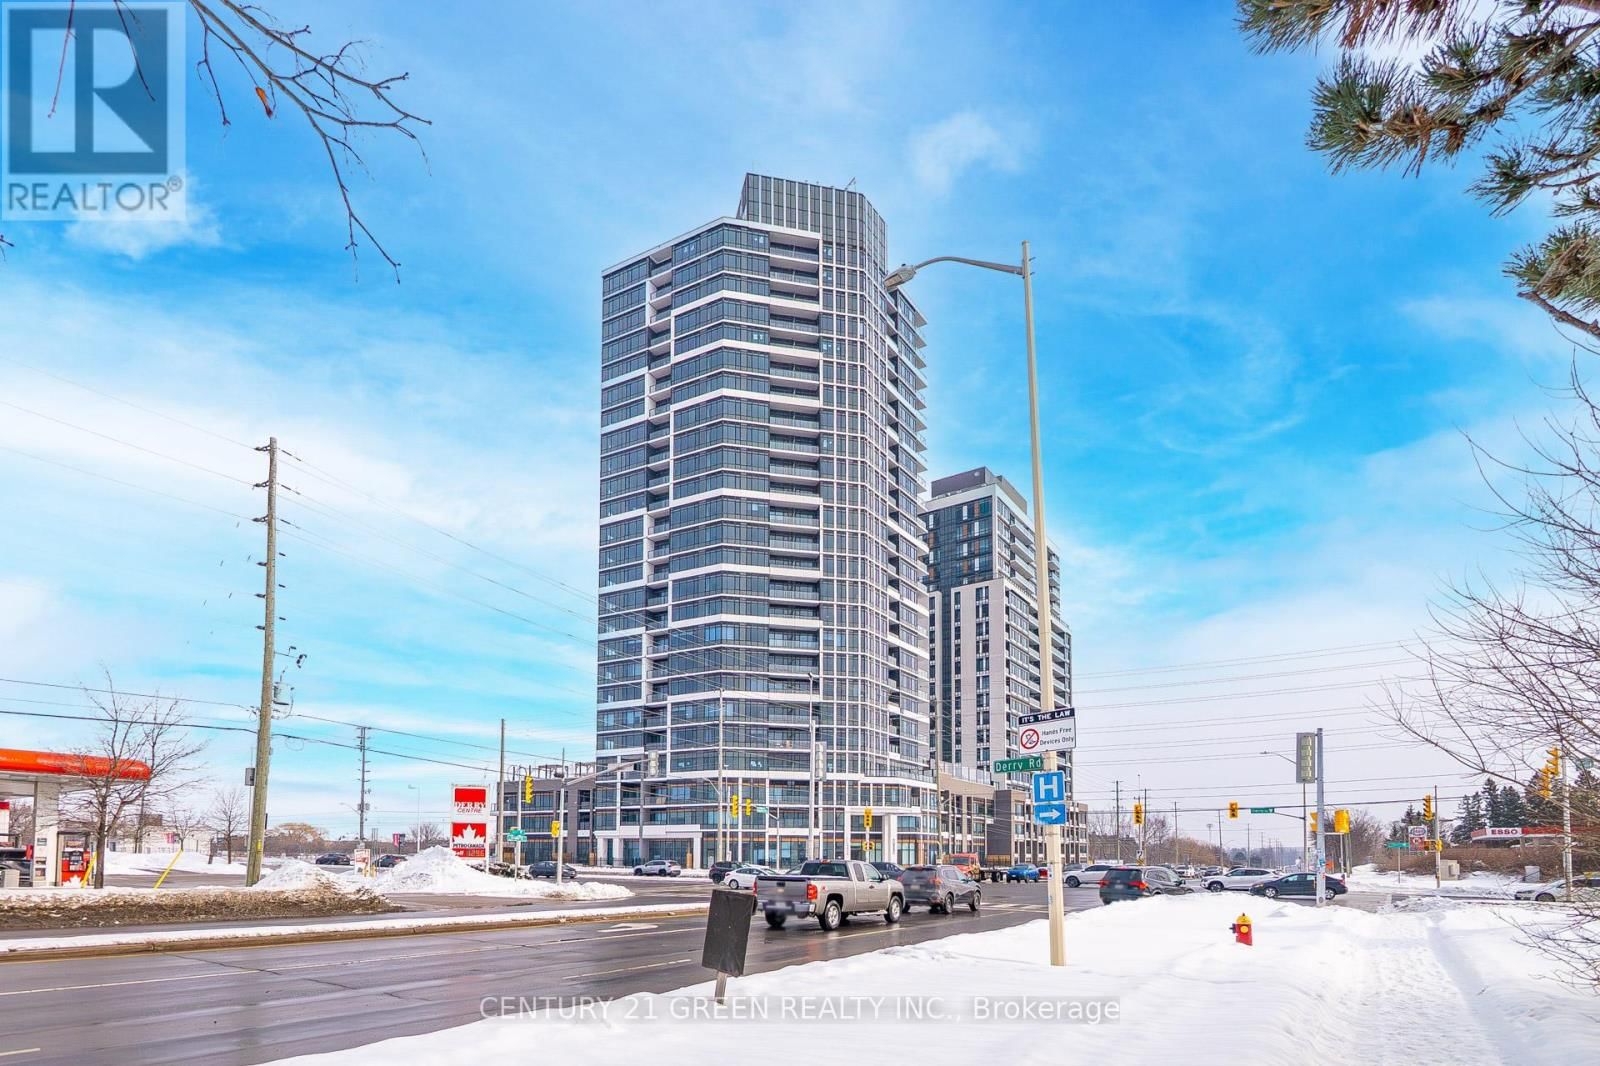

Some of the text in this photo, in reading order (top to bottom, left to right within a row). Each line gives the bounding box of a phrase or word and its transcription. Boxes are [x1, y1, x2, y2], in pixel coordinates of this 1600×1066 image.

[1054, 710, 1070, 718] LAW
[1039, 738, 1061, 746] Devices
[995, 757, 1042, 772] Derry Rd
[1039, 775, 1058, 799] H
